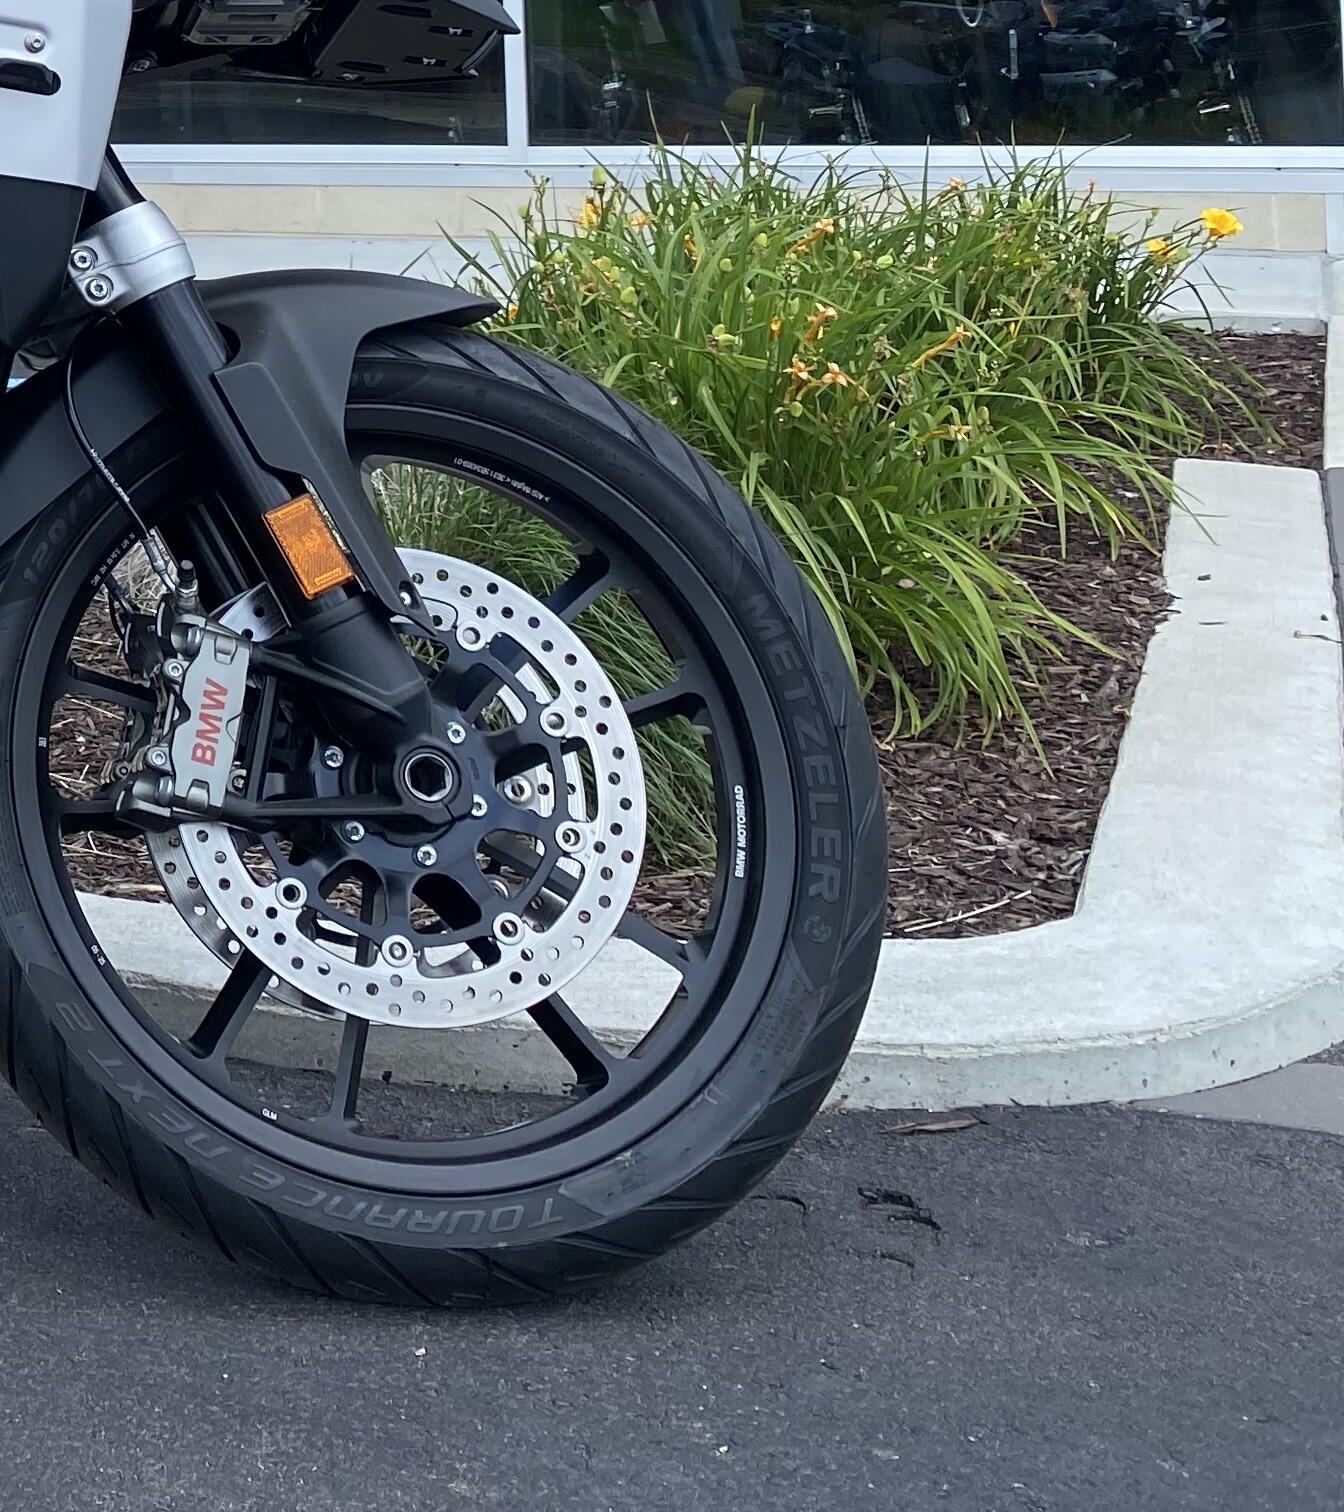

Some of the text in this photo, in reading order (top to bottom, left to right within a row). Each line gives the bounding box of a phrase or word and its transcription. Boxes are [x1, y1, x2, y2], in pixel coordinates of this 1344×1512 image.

[191, 677, 229, 766] BMW
[740, 593, 843, 904] METZELER
[734, 784, 747, 848] MOTORRAD
[55, 1000, 564, 1237] TOURANCE NEXT 2
